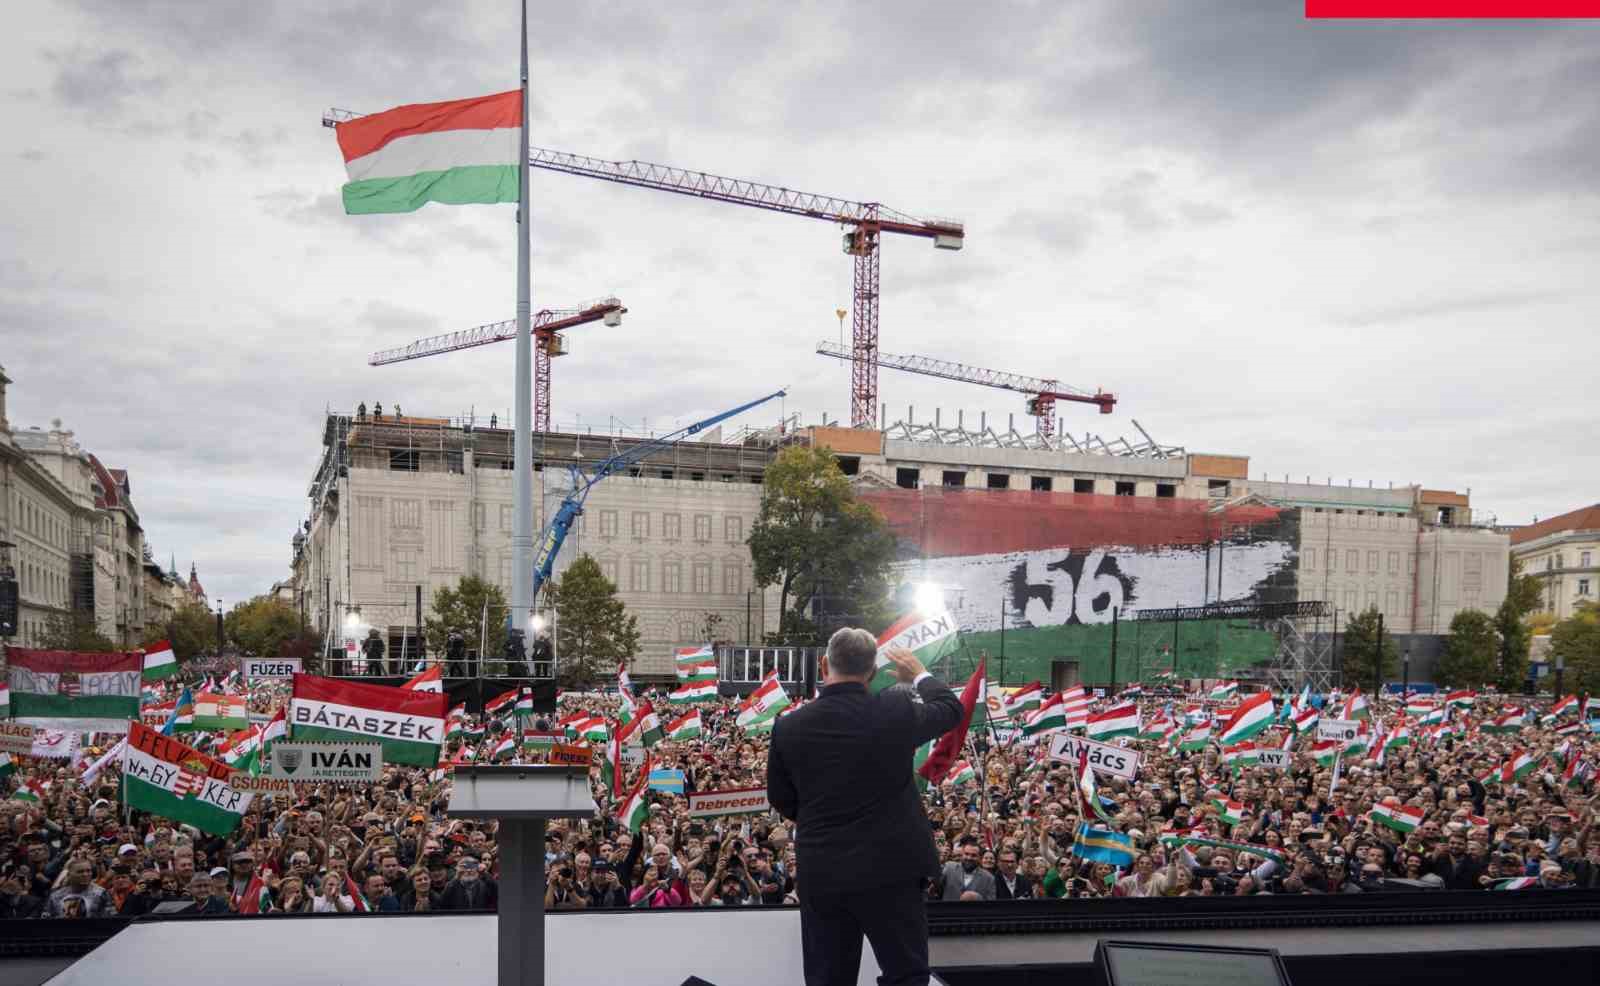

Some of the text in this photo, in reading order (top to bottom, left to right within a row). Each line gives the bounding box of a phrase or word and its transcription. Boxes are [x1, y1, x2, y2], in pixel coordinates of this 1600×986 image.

[1021, 547, 1127, 627] 56
[250, 661, 293, 675] FÜZÉR
[296, 705, 434, 740] BÁTASZÉK
[311, 749, 371, 768] IVÁN
[231, 776, 289, 791] CSORNA
[694, 796, 766, 811] Debrecen
